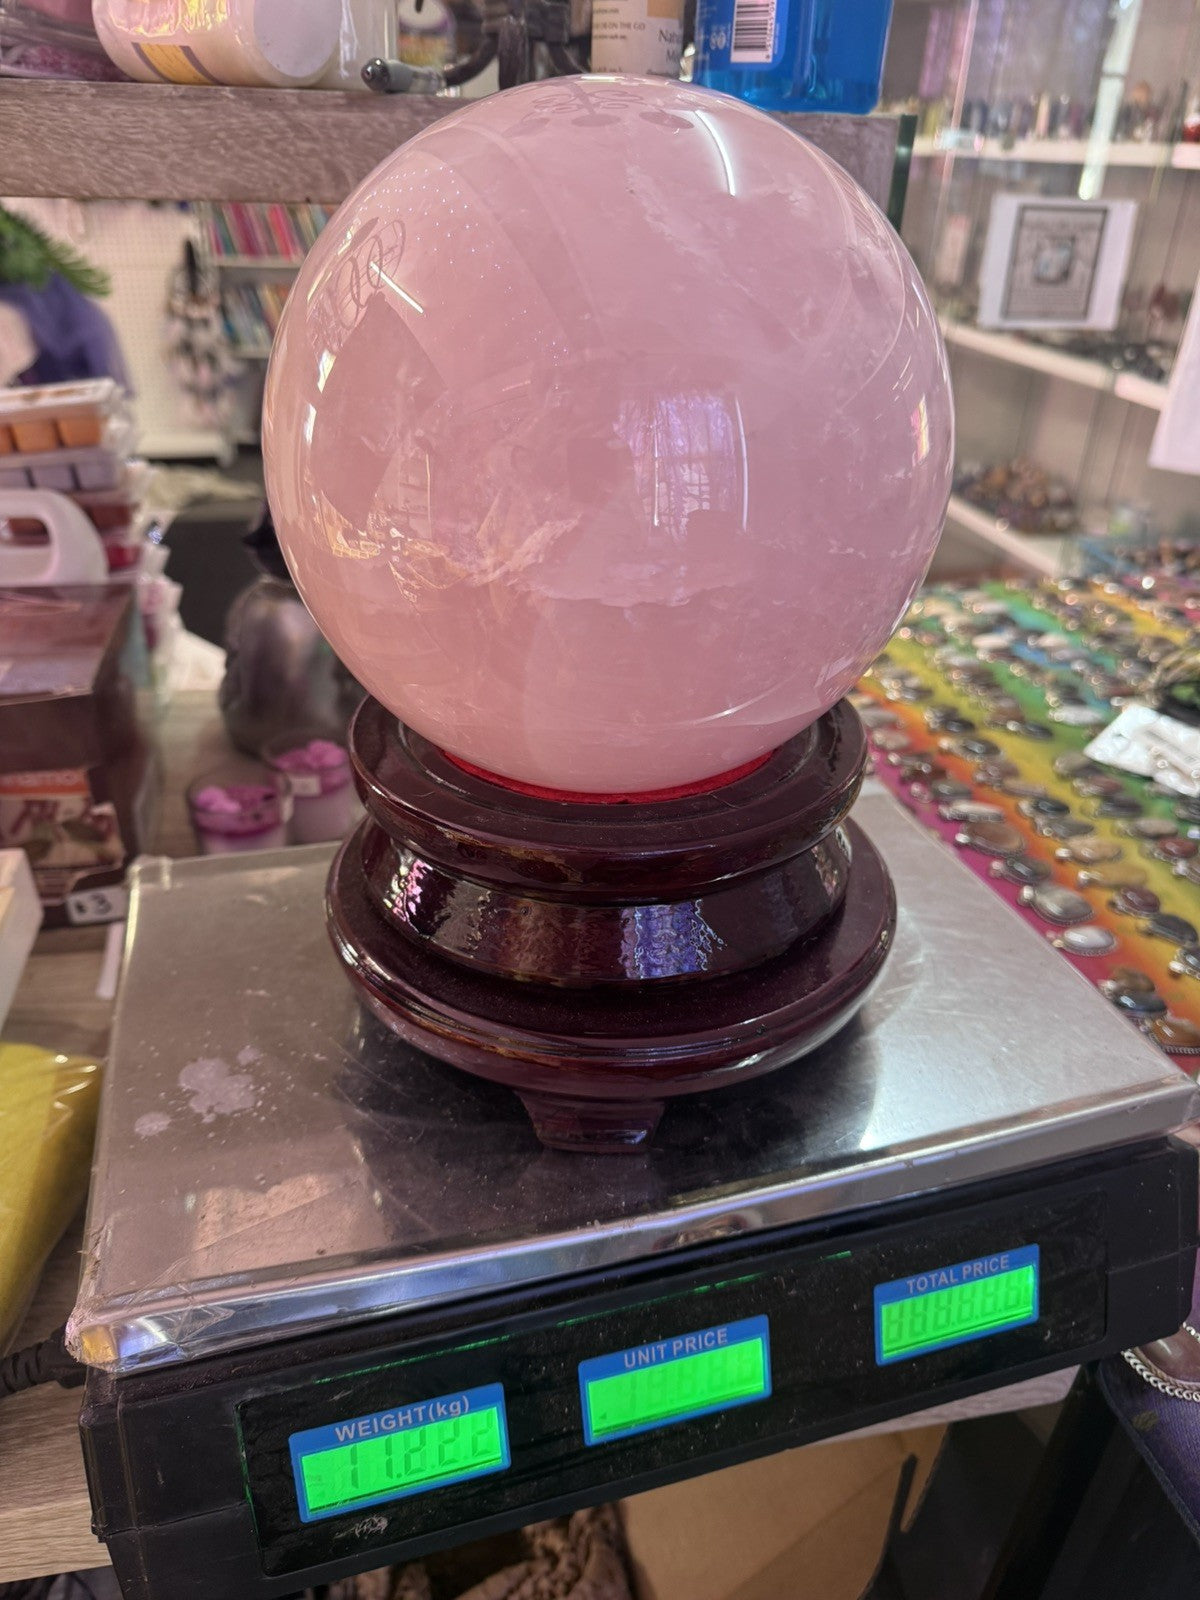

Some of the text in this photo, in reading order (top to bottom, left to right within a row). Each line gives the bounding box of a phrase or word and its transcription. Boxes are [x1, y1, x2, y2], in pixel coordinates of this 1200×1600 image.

[907, 1254, 1010, 1294] TOTAL PRICE
[624, 1327, 729, 1369] UNIT PRICE
[335, 1395, 470, 1442] WEIGHT(kg)
